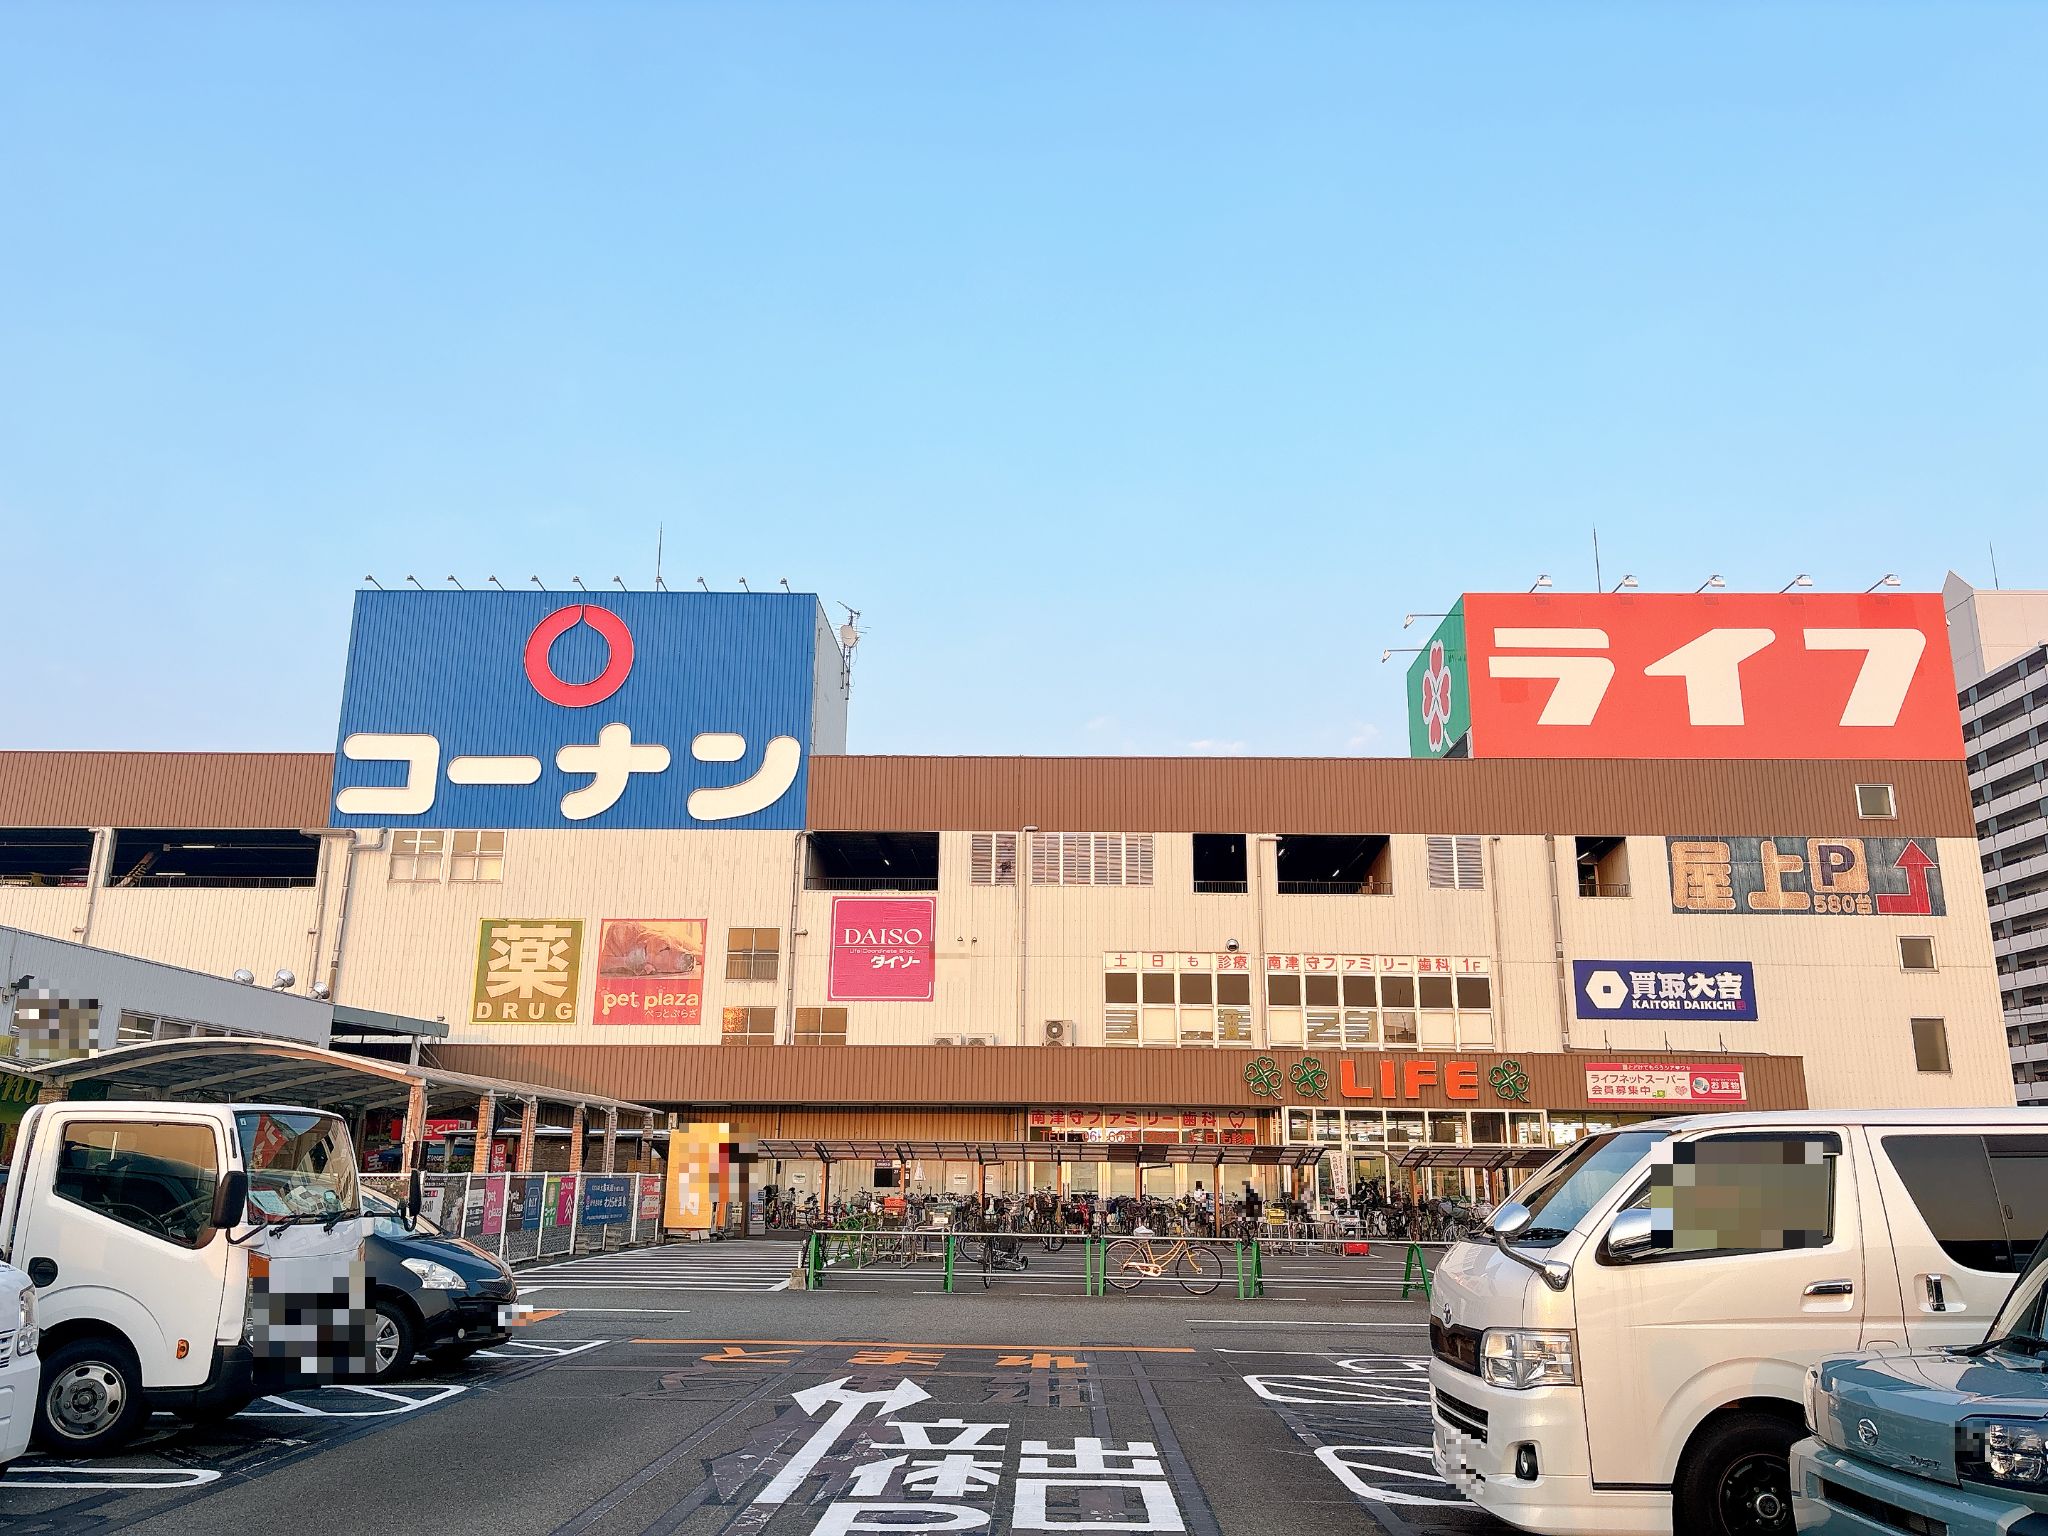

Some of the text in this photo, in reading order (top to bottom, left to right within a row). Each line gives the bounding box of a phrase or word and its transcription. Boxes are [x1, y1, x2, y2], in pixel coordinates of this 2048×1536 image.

[1488, 627, 1927, 727] ライフ
[335, 722, 801, 821] コーナン
[1813, 894, 1873, 914] 580台
[843, 928, 923, 945] DAISO
[486, 925, 574, 999] 薬
[870, 955, 921, 969] ダイソー
[1114, 953, 1249, 970] 土日も診療
[1267, 954, 1481, 973] 南津守ファミリー歯科 1F
[1628, 971, 1743, 999] 買取大吉
[476, 1002, 573, 1020] DRUG
[601, 989, 699, 1016] pet plaza
[1632, 1000, 1736, 1010] KAITORI DAIKICHI
[644, 1008, 699, 1019] ぺっとぷらざ
[1339, 1058, 1479, 1100] LIFE
[1590, 1073, 1686, 1084] ライフネットスーパー
[1591, 1085, 1651, 1096] 会員募集中
[1030, 1109, 1217, 1125] 南津守ファミリー歯科
[700, 1346, 1089, 1370] とまれ
